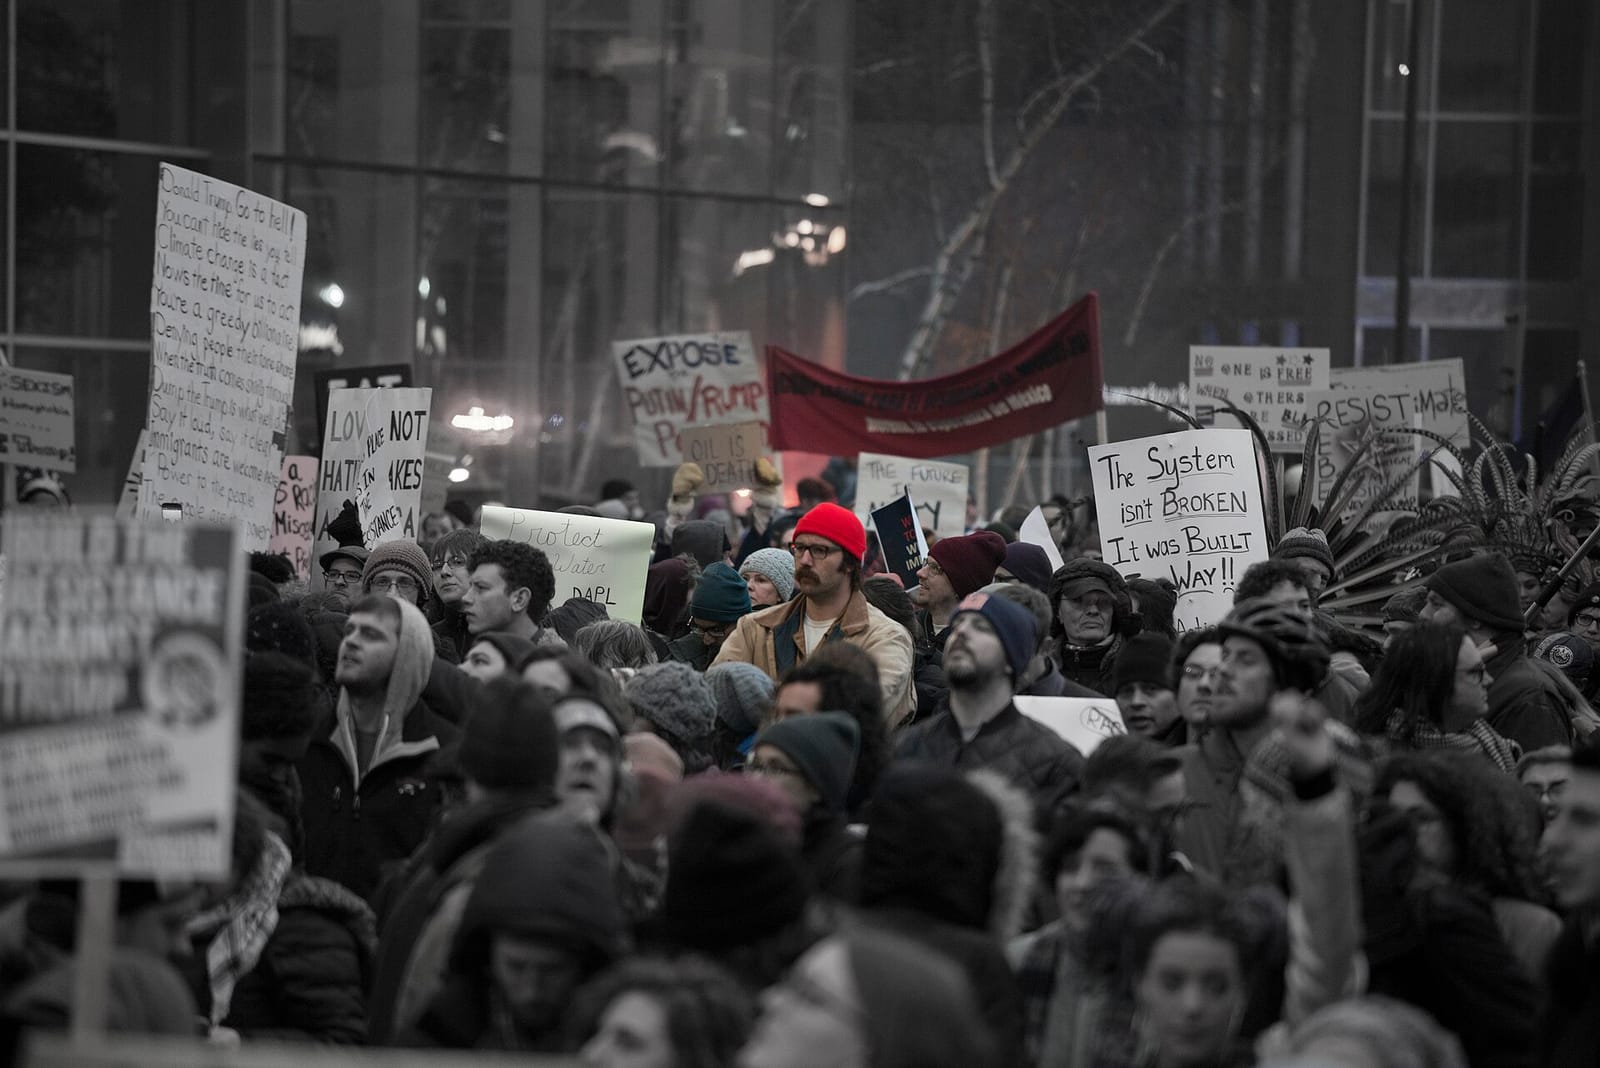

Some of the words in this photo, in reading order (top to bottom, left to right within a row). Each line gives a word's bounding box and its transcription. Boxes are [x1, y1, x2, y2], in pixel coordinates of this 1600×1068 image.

[161, 199, 181, 226] You
[203, 181, 233, 219] Trump
[236, 190, 250, 219] Go
[254, 200, 265, 223] to
[158, 223, 202, 260] Climate
[193, 302, 203, 319] a
[207, 304, 251, 343] greedy
[622, 341, 741, 379] EXPOSE
[1260, 367, 1272, 380] IS
[1277, 367, 1312, 381] FREE
[151, 393, 177, 433] Say
[331, 410, 366, 442] LOV
[389, 410, 427, 442] NOT
[1316, 394, 1411, 430] RESIST
[212, 449, 231, 471] are
[691, 439, 720, 461] OIL
[729, 434, 745, 458] IS
[158, 451, 193, 486] Power
[197, 474, 208, 489] to
[362, 467, 375, 491] IN
[866, 460, 898, 480] THE
[911, 464, 962, 485] FUTURE
[1098, 453, 1136, 490] The
[1147, 446, 1236, 492] System
[1121, 497, 1154, 524] isn't
[509, 511, 604, 549] Protect
[1107, 537, 1141, 566] It
[1145, 538, 1181, 559] was
[573, 586, 617, 606] DAPL
